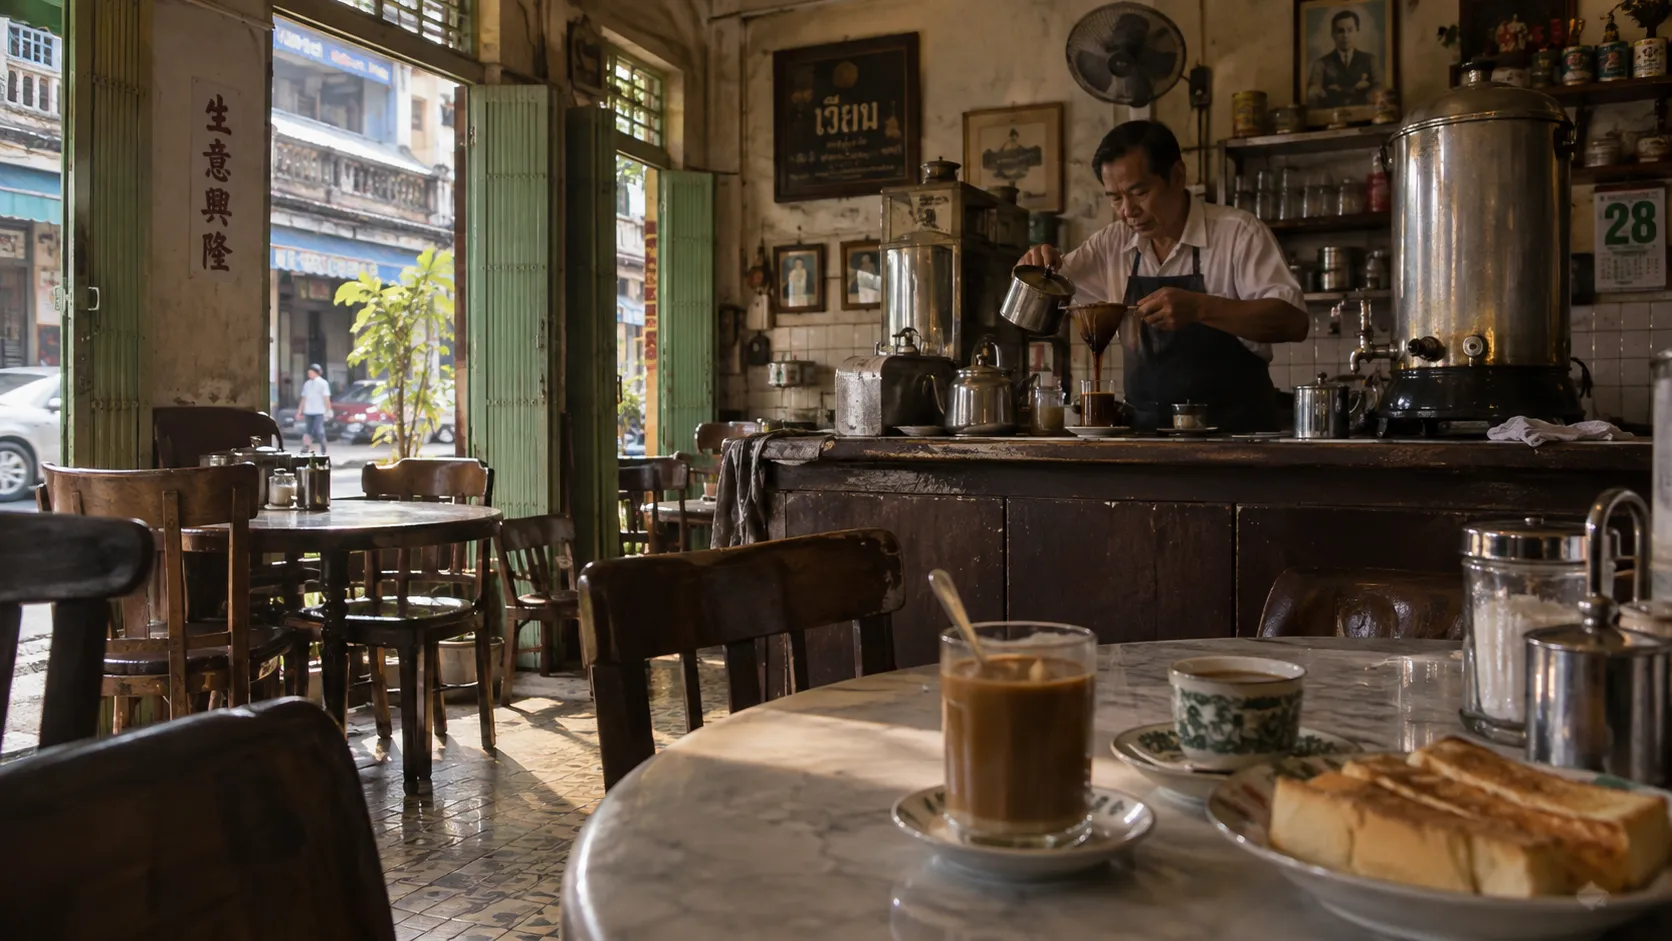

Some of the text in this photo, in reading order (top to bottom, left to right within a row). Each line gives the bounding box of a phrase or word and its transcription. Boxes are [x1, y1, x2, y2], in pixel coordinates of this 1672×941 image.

[201, 94, 233, 272] 生意興隆
[1604, 200, 1657, 246] 28
